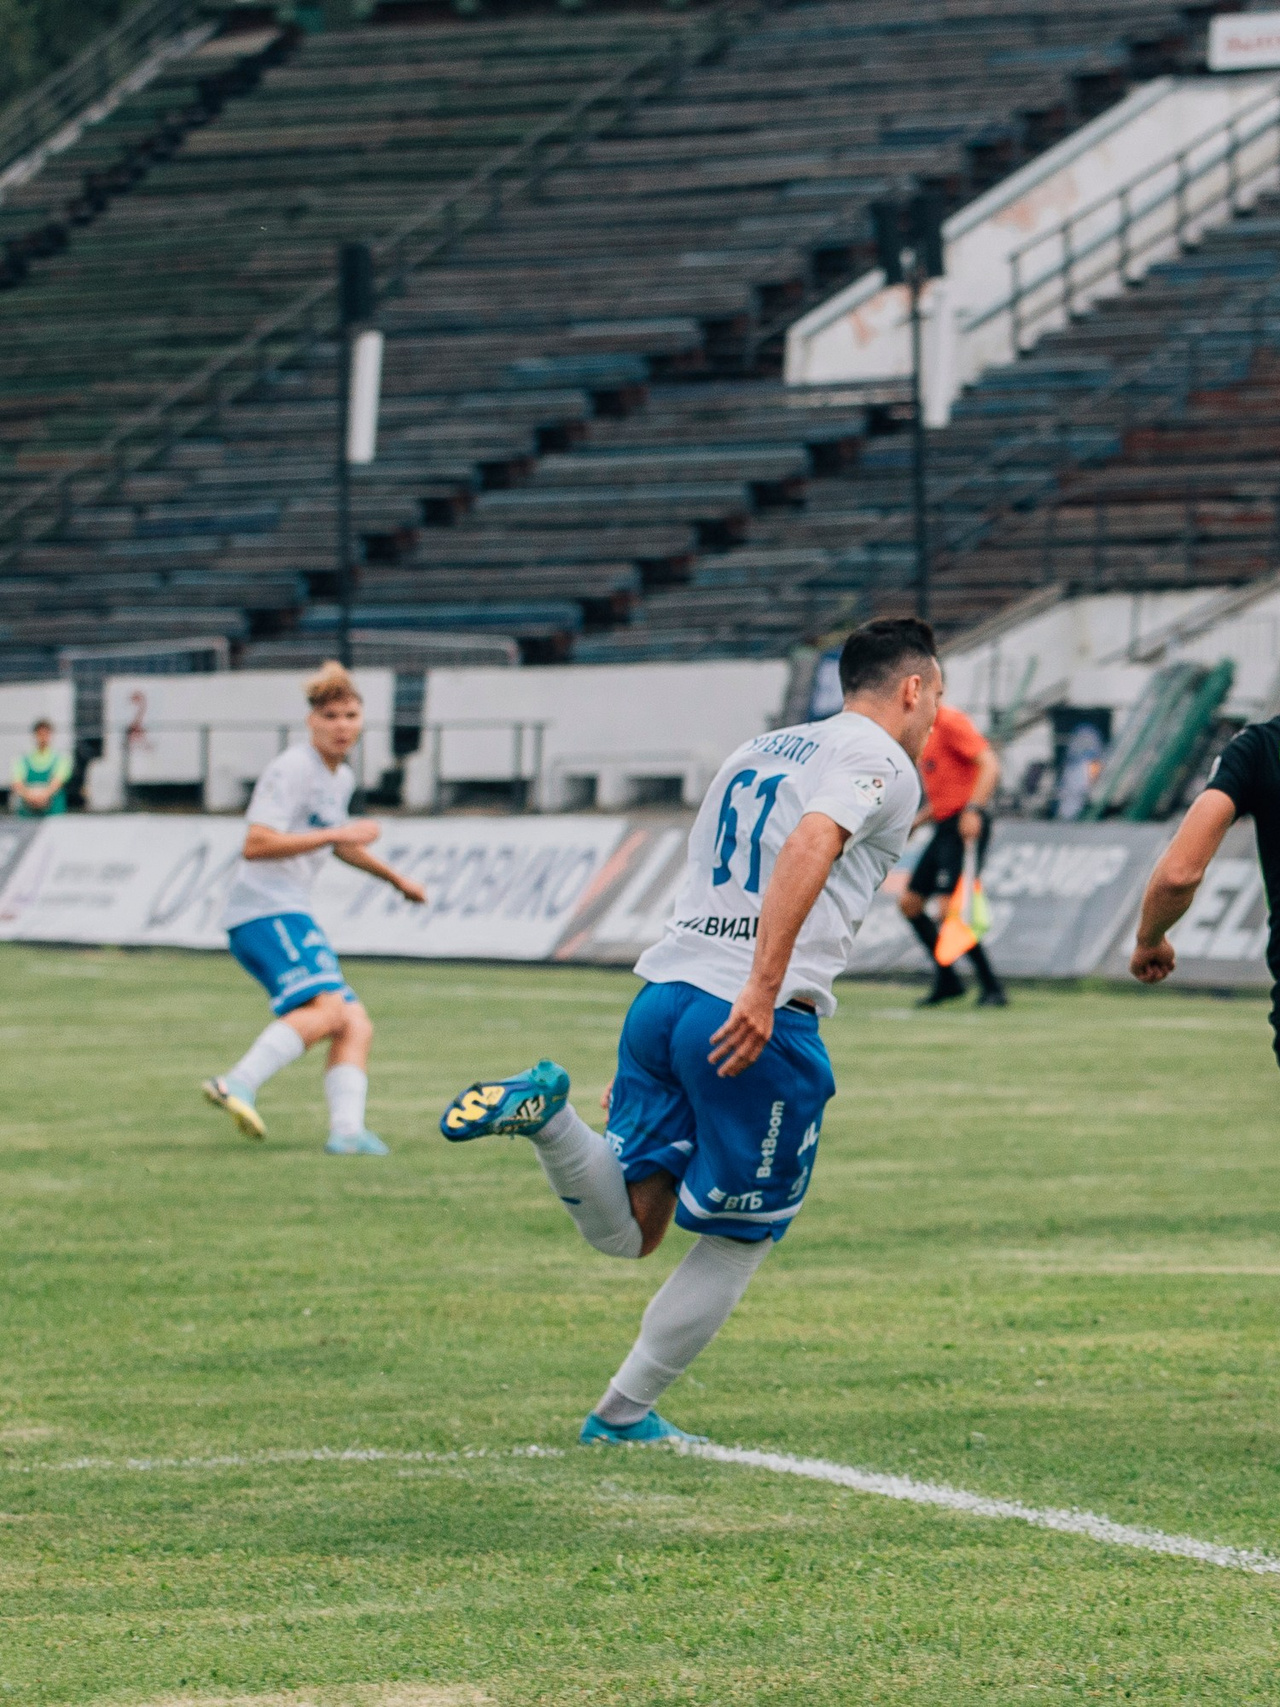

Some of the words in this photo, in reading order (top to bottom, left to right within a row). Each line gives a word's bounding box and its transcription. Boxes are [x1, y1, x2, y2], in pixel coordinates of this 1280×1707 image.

[711, 768, 789, 894] 61
[756, 1100, 785, 1178] BetBoom
[724, 1190, 763, 1210] ВТБ
